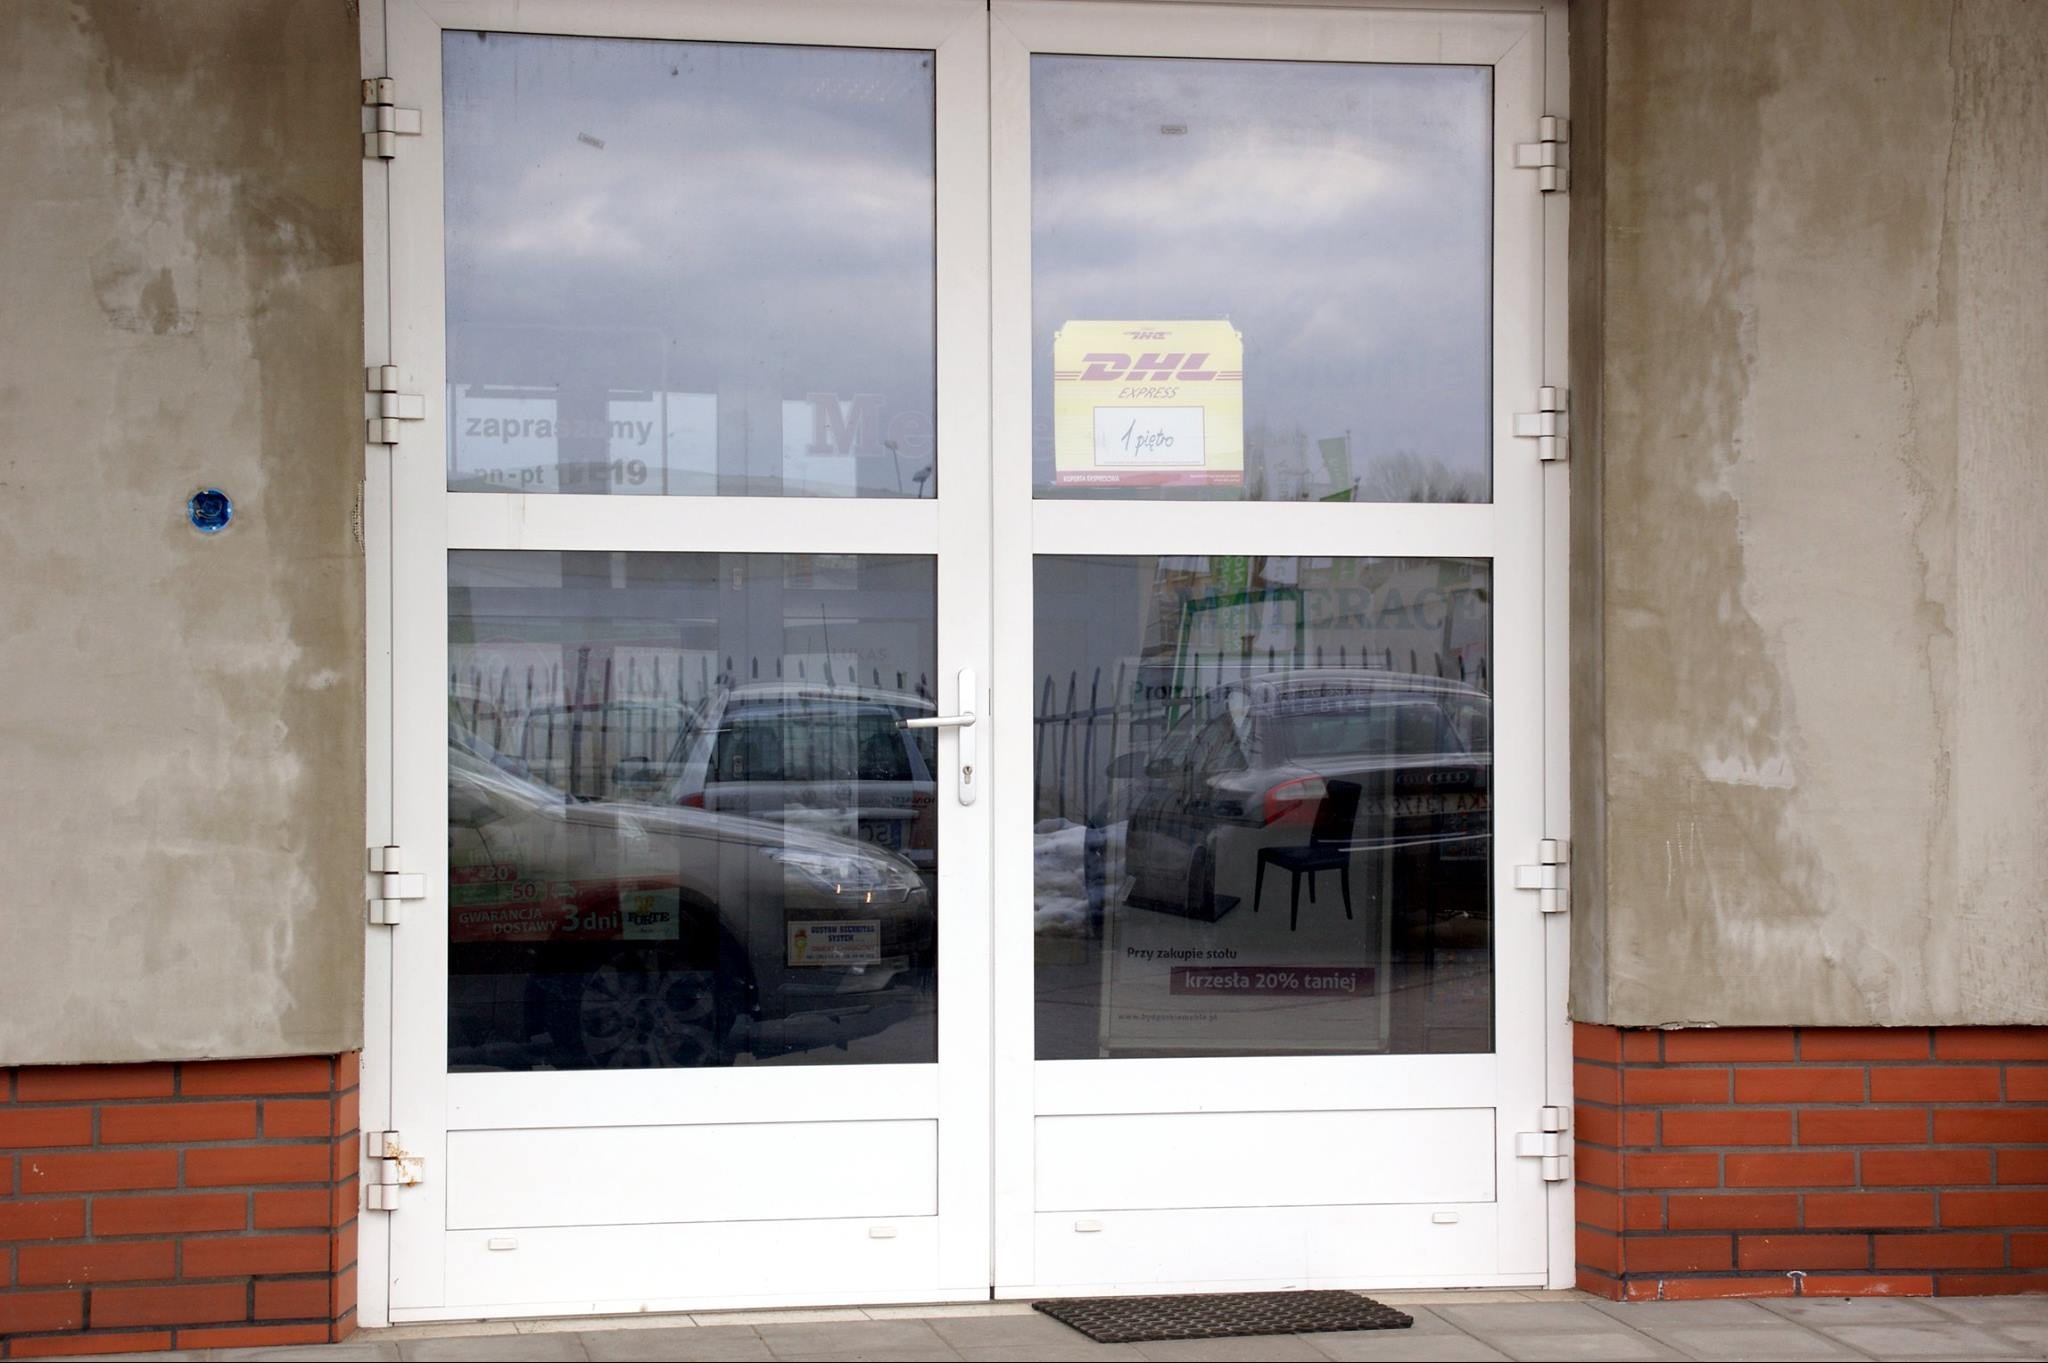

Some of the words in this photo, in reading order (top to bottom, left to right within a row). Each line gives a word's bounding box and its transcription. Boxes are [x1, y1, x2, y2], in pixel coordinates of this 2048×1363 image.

[1080, 352, 1218, 381] DHL
[1118, 387, 1180, 400] EXPRESS
[1121, 418, 1137, 451] 1
[458, 907, 543, 925] GWARANCJA
[583, 911, 618, 931] dni
[492, 919, 558, 935] DOSTAWY
[1127, 947, 1154, 962] Przy
[1156, 947, 1204, 961] zakupie
[1185, 971, 1250, 989] krzesła
[1255, 973, 1299, 989] 20%
[1304, 972, 1356, 993] taniej
